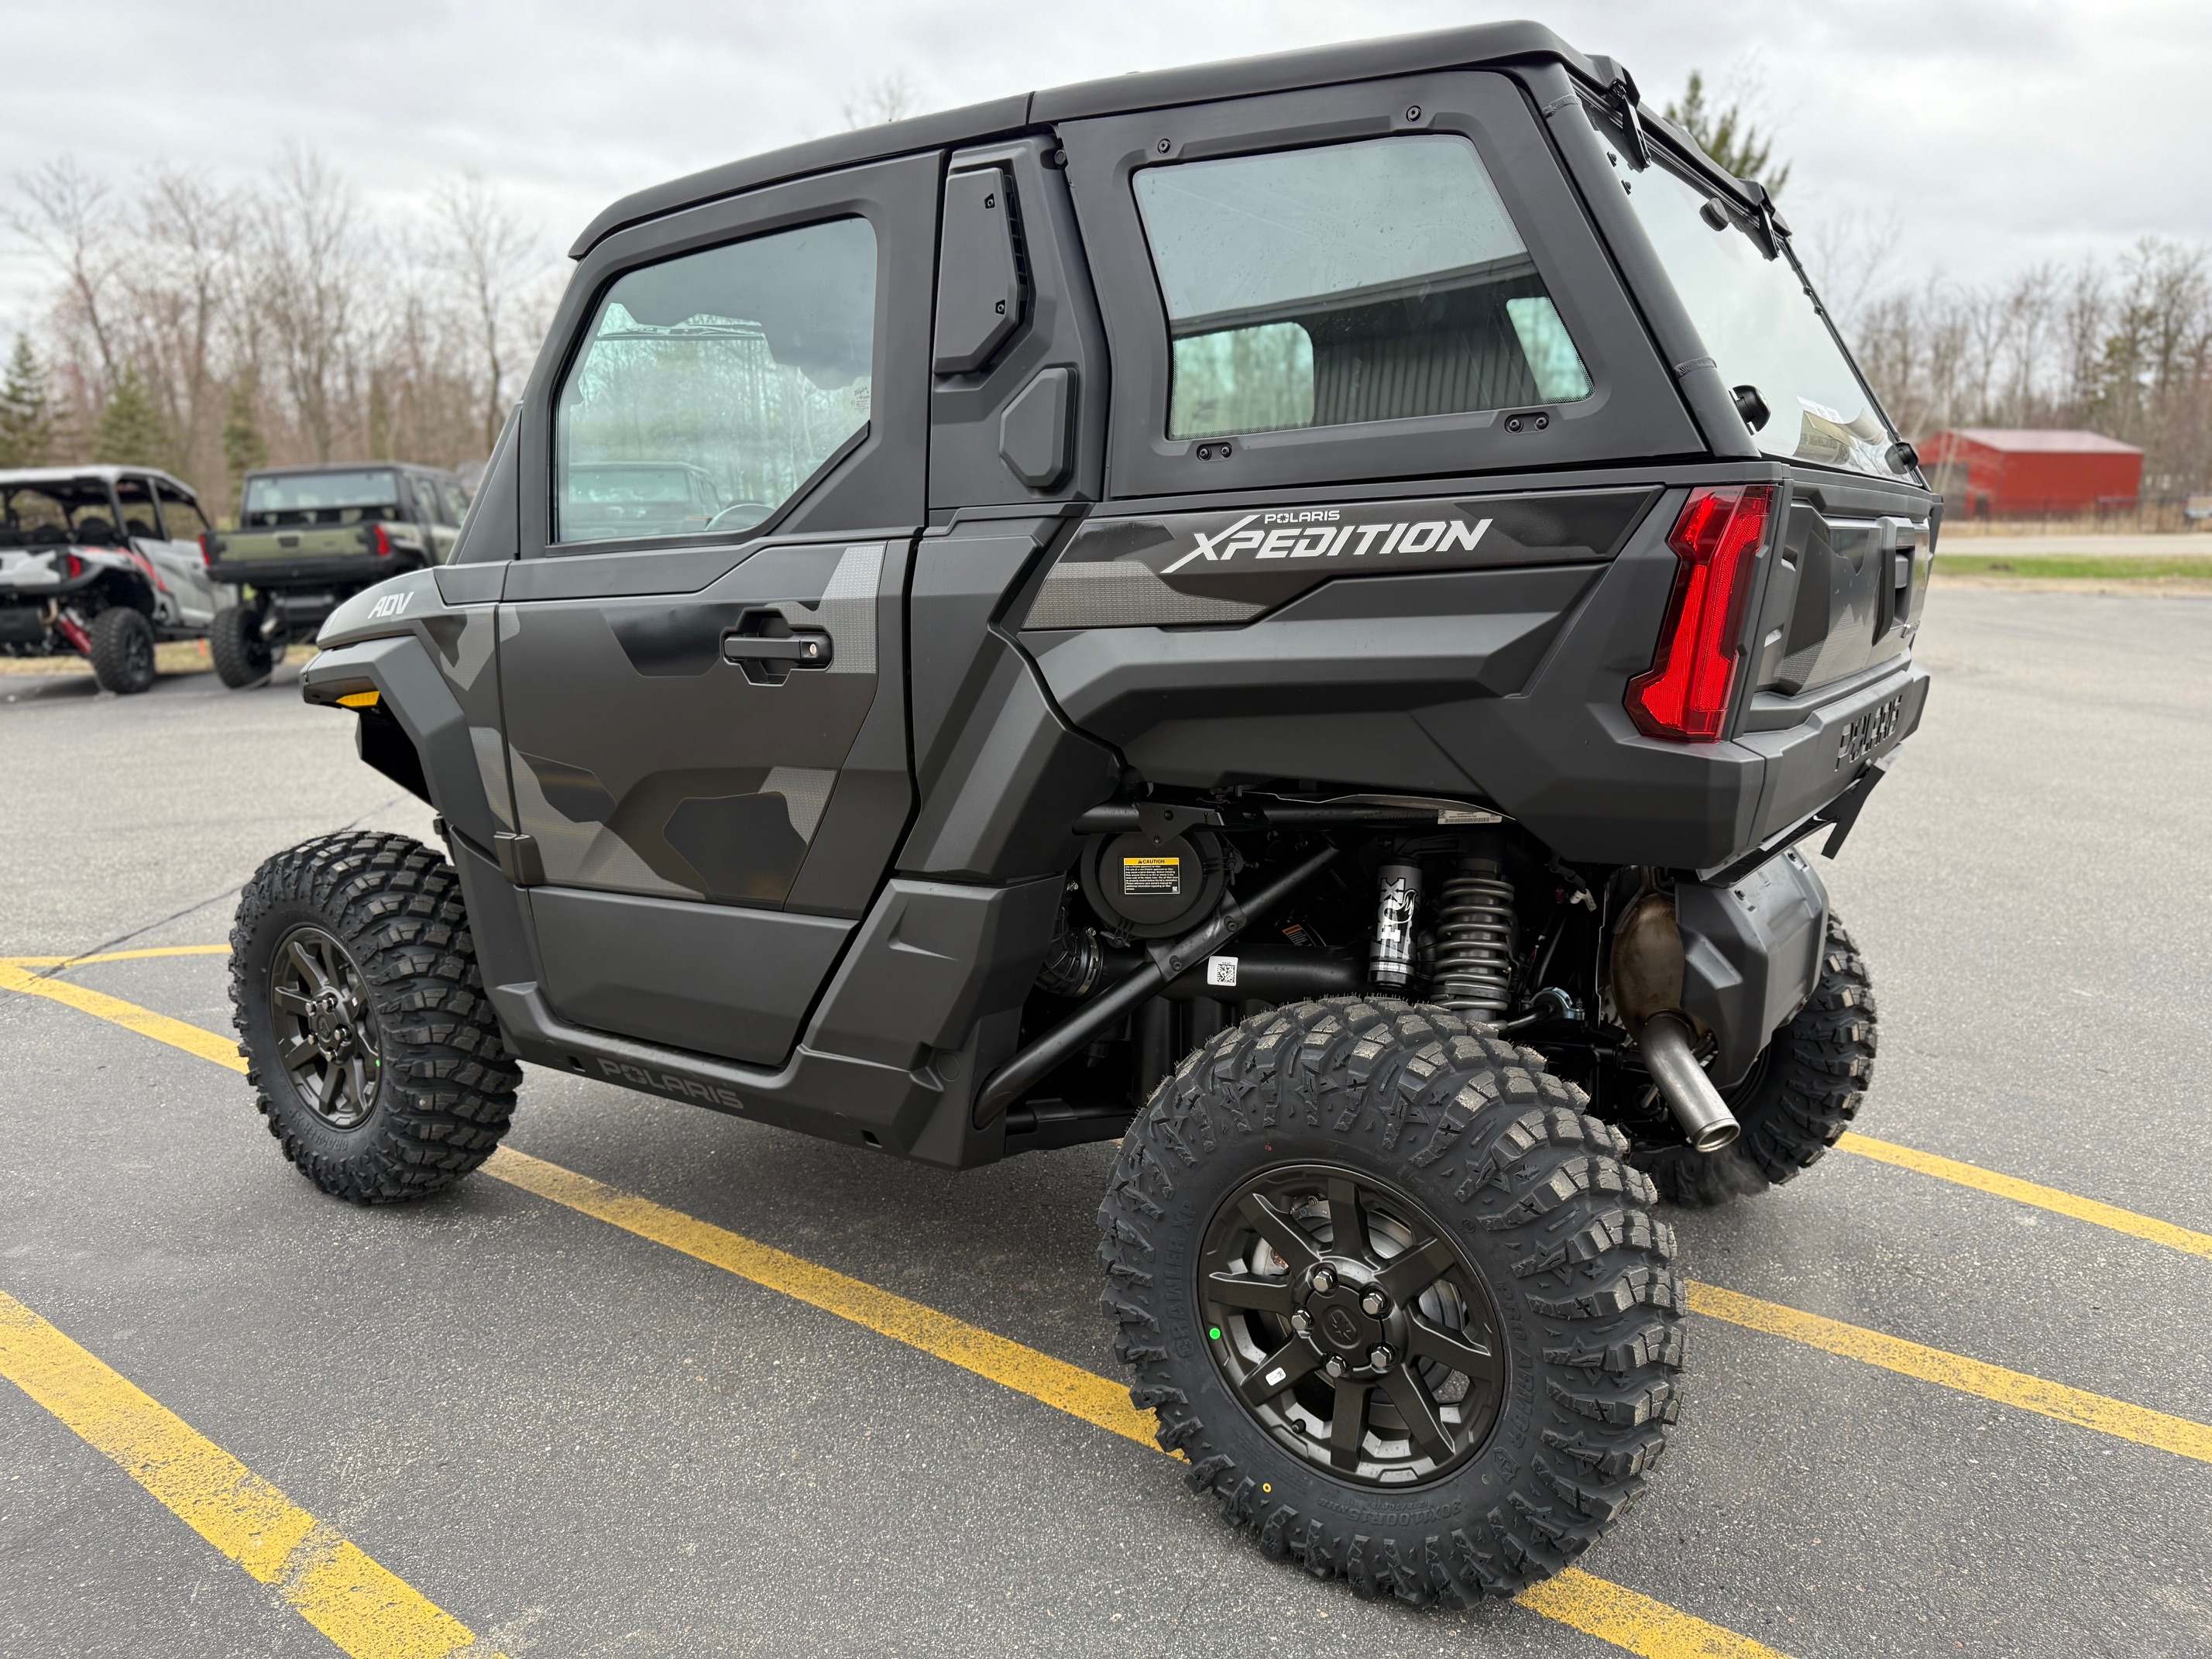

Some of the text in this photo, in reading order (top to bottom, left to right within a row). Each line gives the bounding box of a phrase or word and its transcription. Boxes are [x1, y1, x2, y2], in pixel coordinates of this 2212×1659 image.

[1160, 514, 1493, 573] XPEDITION
[1264, 510, 1341, 524] POLARIS
[367, 591, 415, 619] ADV
[1377, 878, 1417, 943] FOX
[596, 1057, 744, 1110] POLARIS
[1164, 1200, 1197, 1358] CRAWLER XP
[1508, 1347, 1534, 1449] ARMOR
